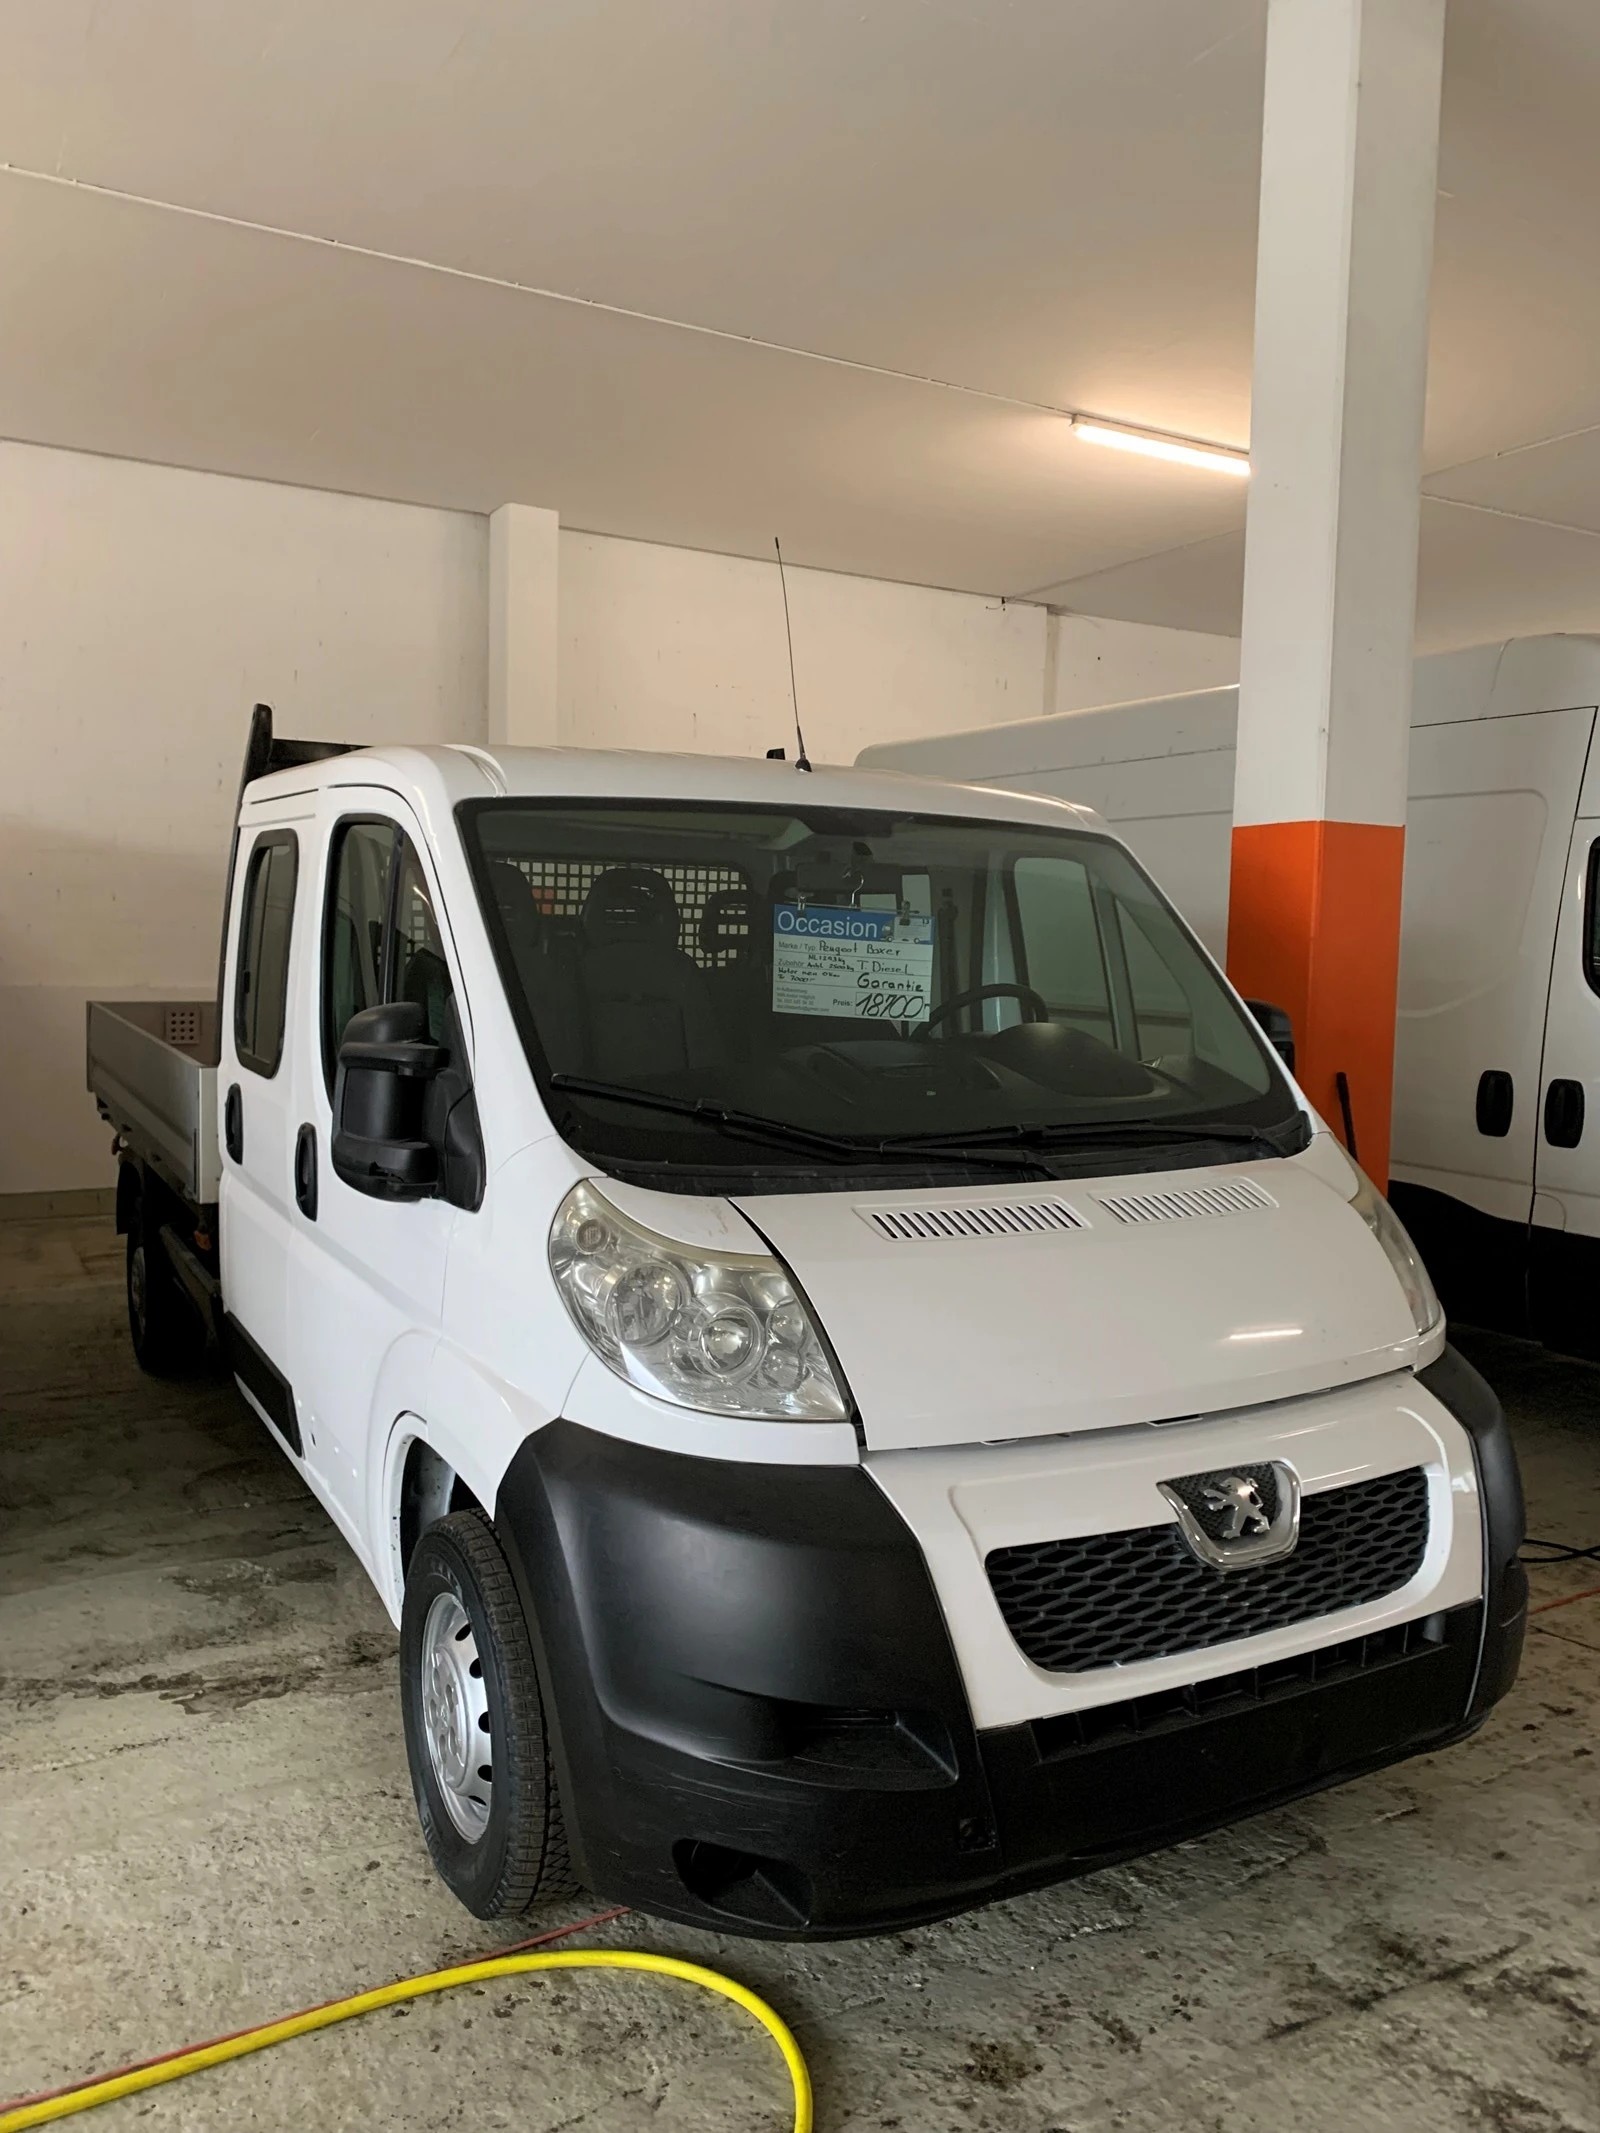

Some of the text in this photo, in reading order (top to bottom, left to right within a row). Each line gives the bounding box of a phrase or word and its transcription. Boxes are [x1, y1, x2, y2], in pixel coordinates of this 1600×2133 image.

[777, 910, 878, 938] Occasion
[778, 941, 798, 949] Marke
[819, 939, 857, 956] Peugeot
[867, 943, 901, 956] Boxer
[857, 972, 924, 992] Garantie
[832, 998, 854, 1007] Preis:
